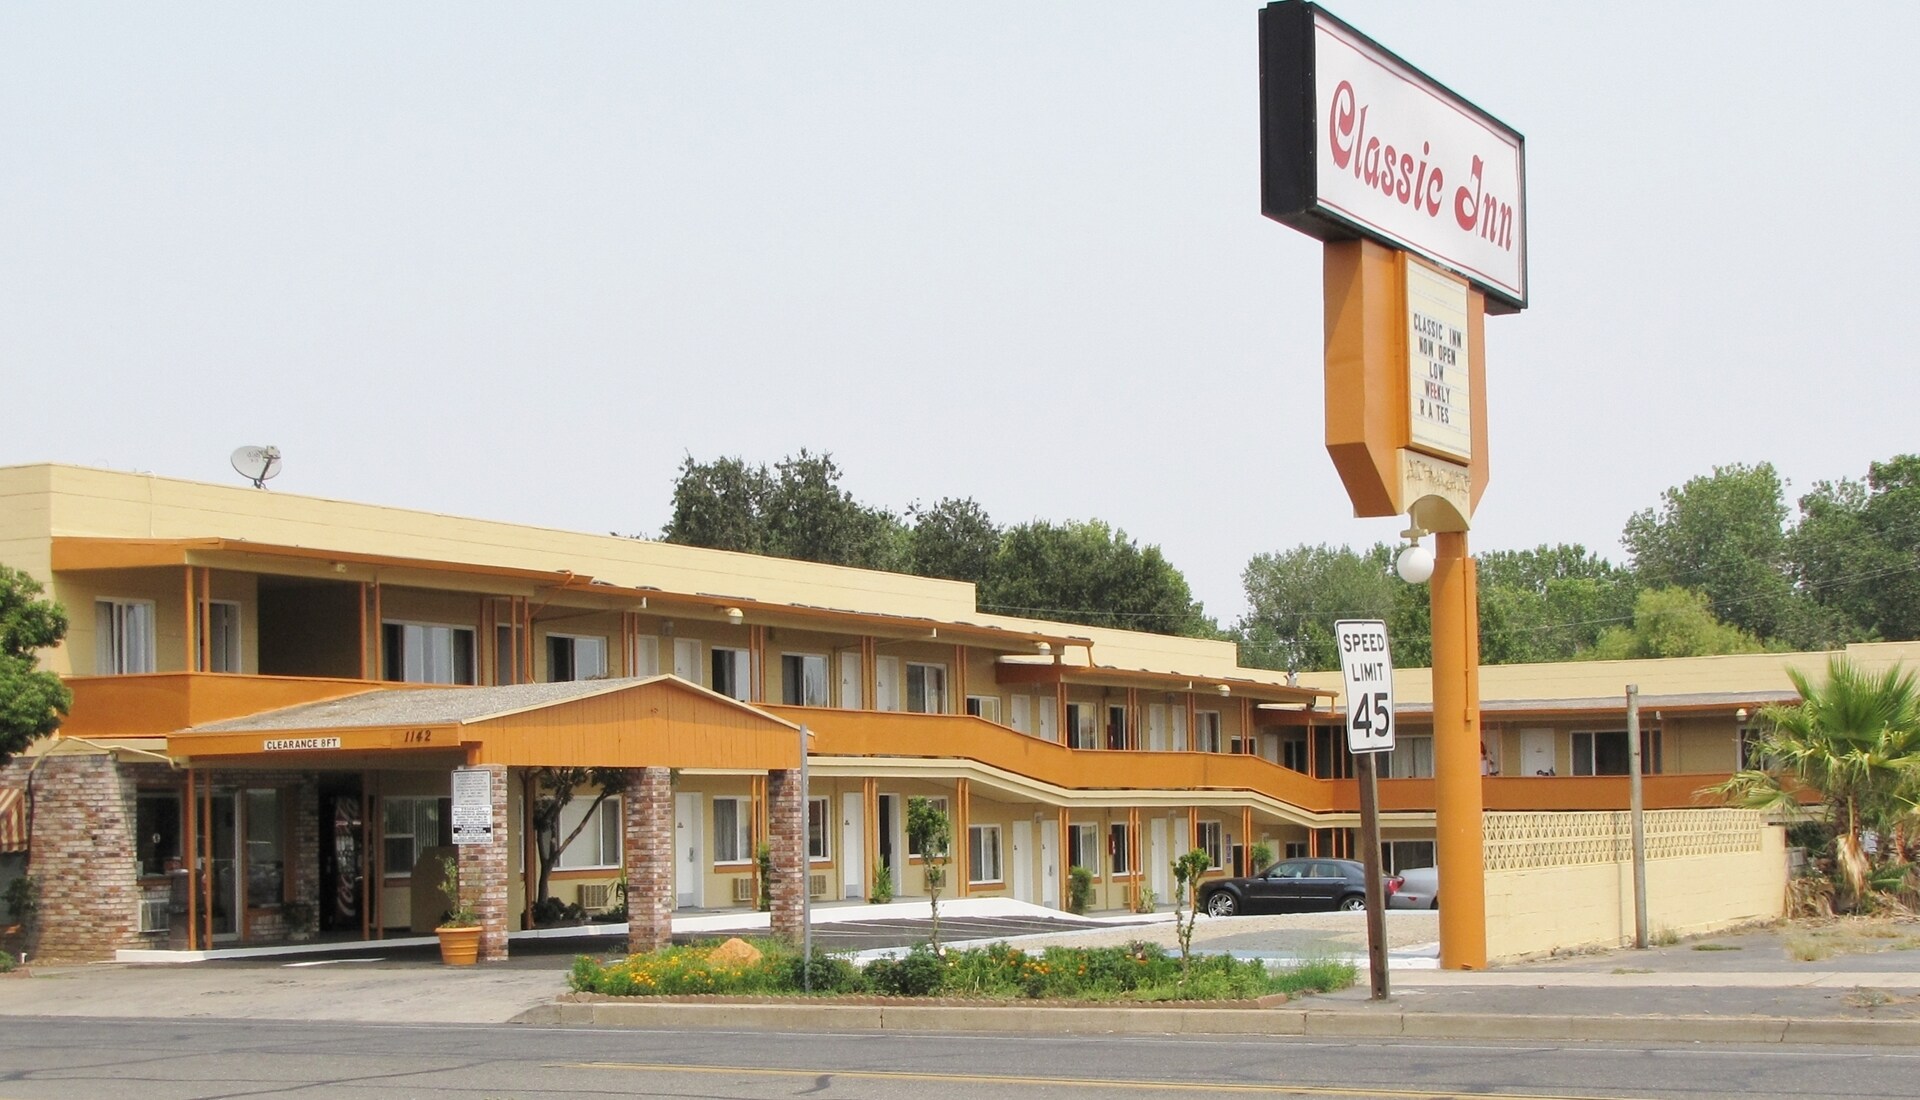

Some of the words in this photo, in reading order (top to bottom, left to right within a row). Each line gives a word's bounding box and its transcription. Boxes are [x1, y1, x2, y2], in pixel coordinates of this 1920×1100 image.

[1329, 80, 1443, 217] Classic
[1454, 154, 1513, 251] Inn
[1414, 313, 1442, 340] CLASSIC
[1449, 328, 1461, 348] INN
[1419, 336, 1433, 357] NOW
[1439, 345, 1455, 365] OPEN
[1429, 361, 1443, 381] LOW
[1424, 380, 1450, 403] WEEKLY
[1343, 634, 1384, 652] SPEED
[1352, 663, 1383, 681] LIMIT
[1352, 692, 1389, 738] 45
[266, 739, 318, 750] CLEARANCE
[321, 738, 337, 748] 8FT
[404, 729, 431, 743] 1142
